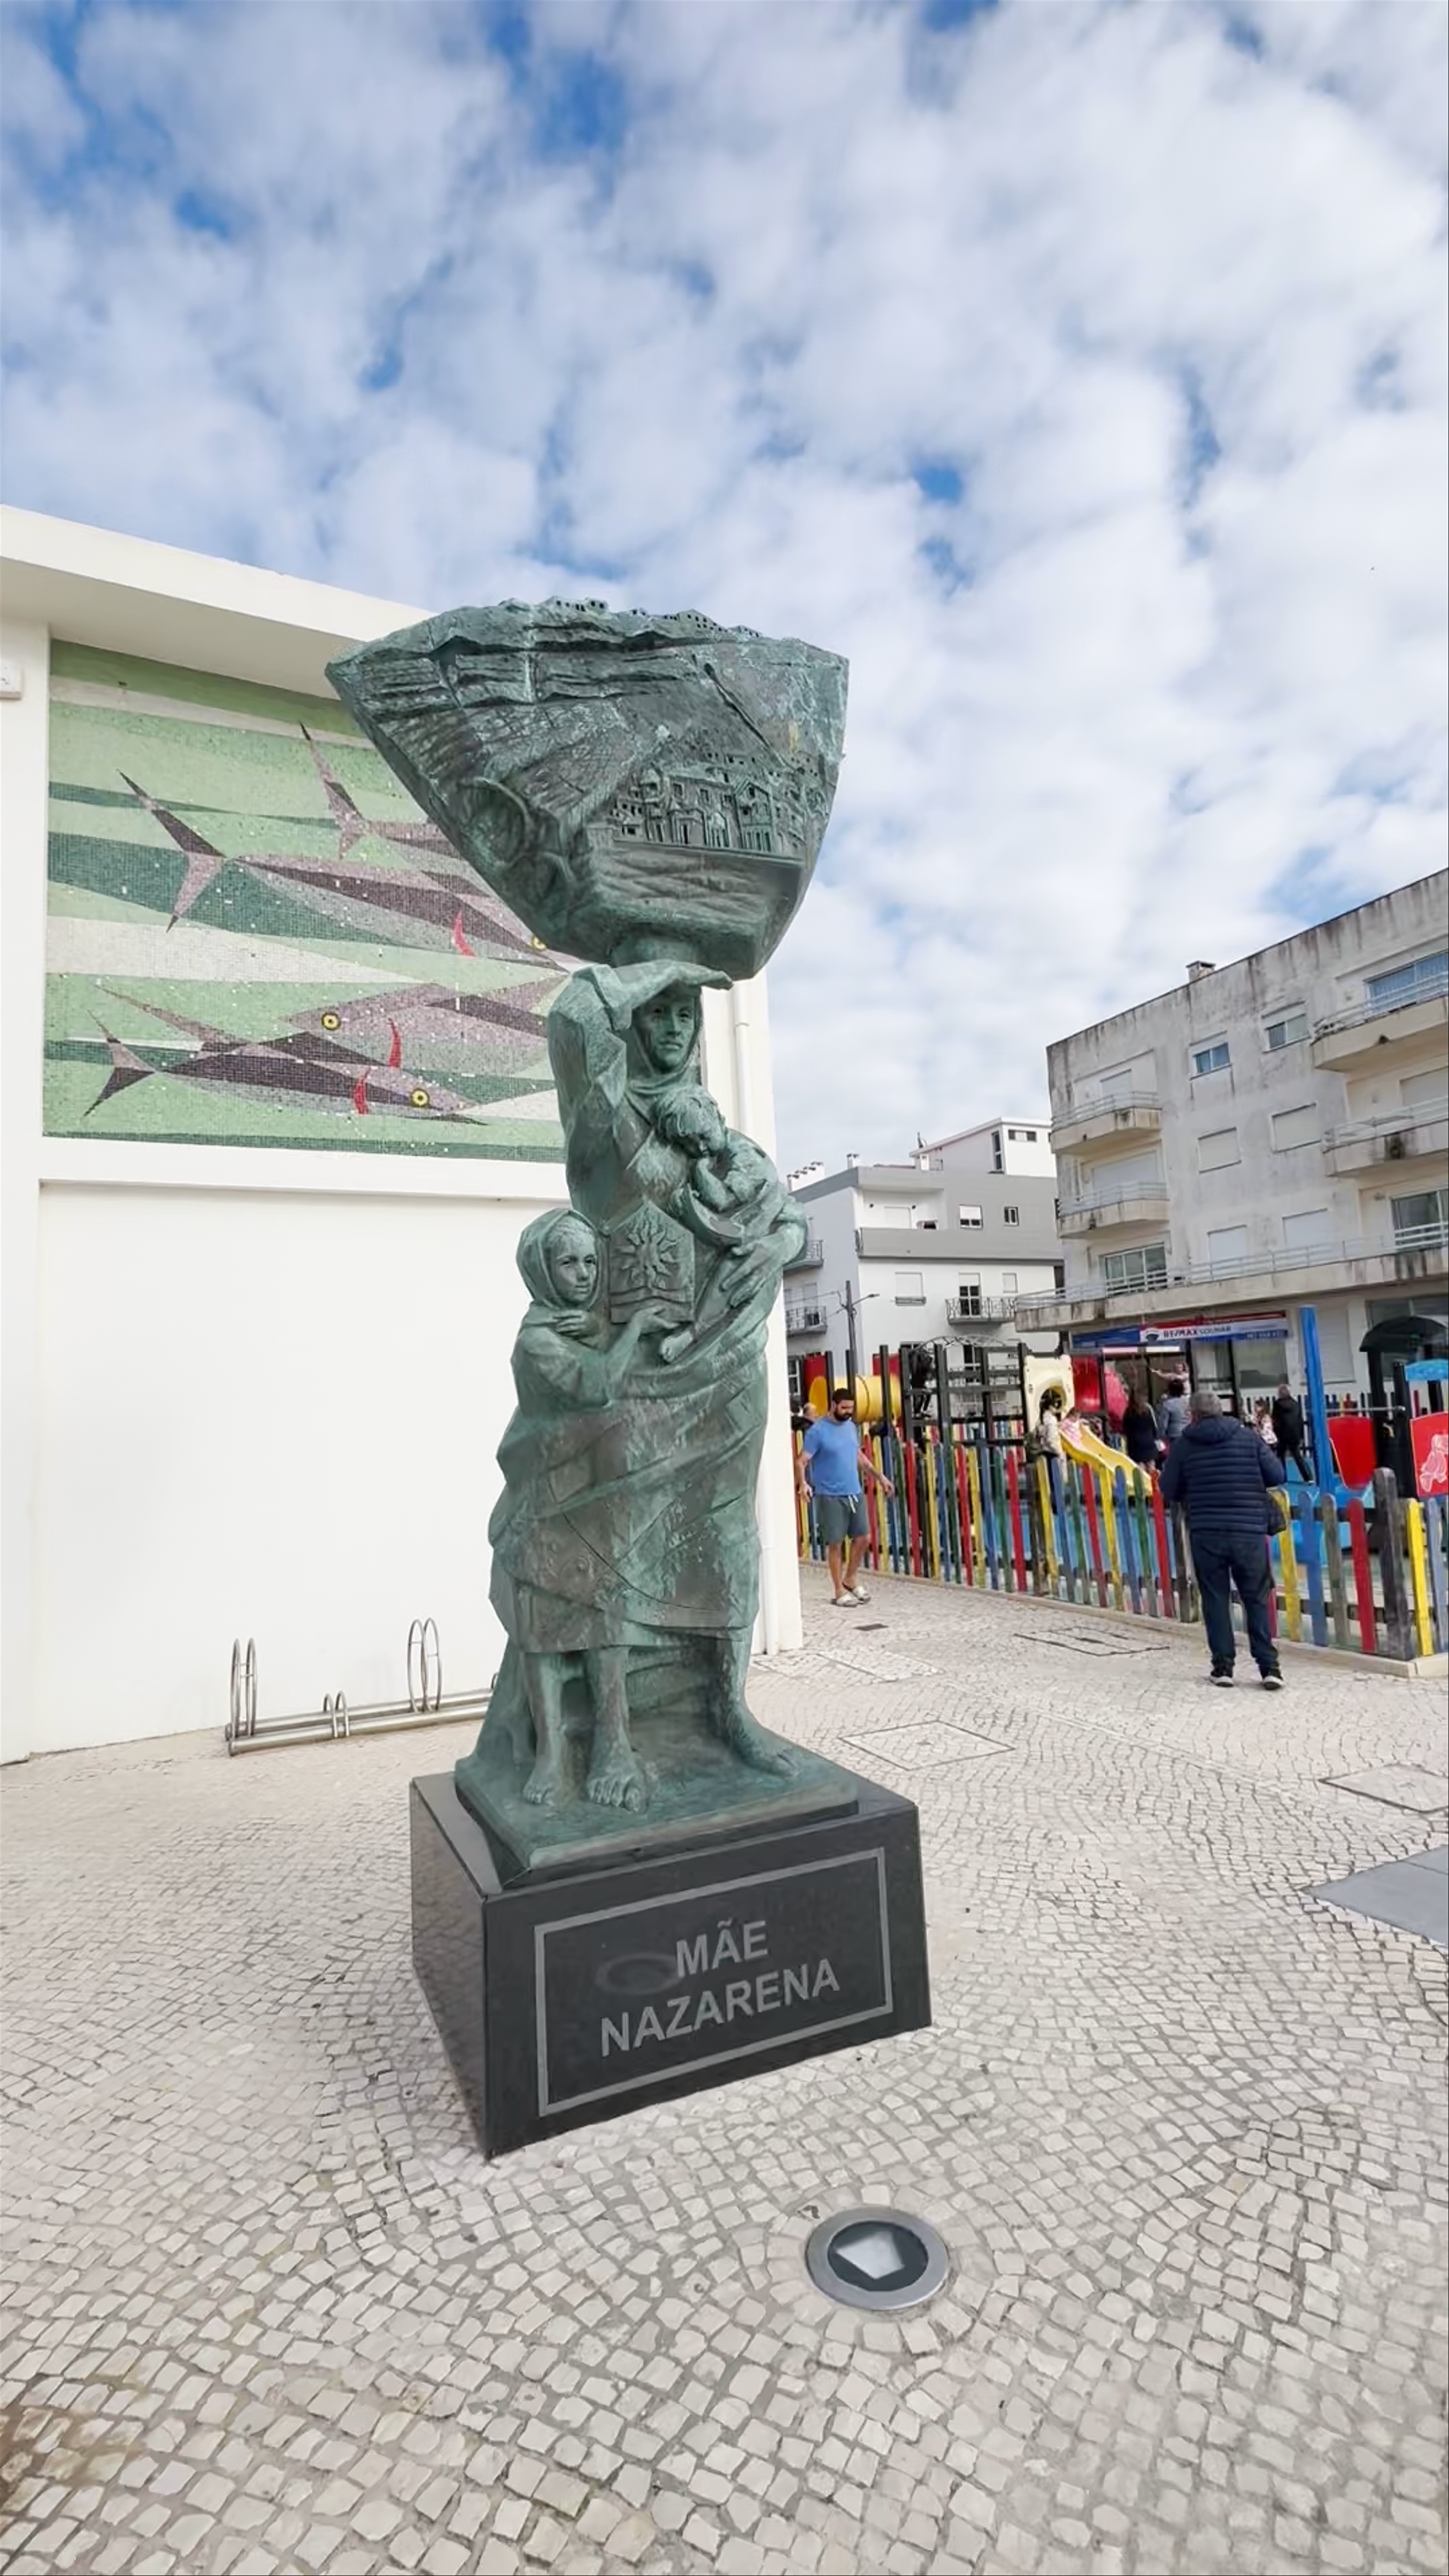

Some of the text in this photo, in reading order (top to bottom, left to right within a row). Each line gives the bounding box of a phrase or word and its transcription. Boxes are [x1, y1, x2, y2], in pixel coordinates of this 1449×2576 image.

[1163, 1329, 1198, 1338] RE/MAX
[675, 1919, 769, 1977] MÃE
[601, 1958, 840, 2057] NAZARENA
